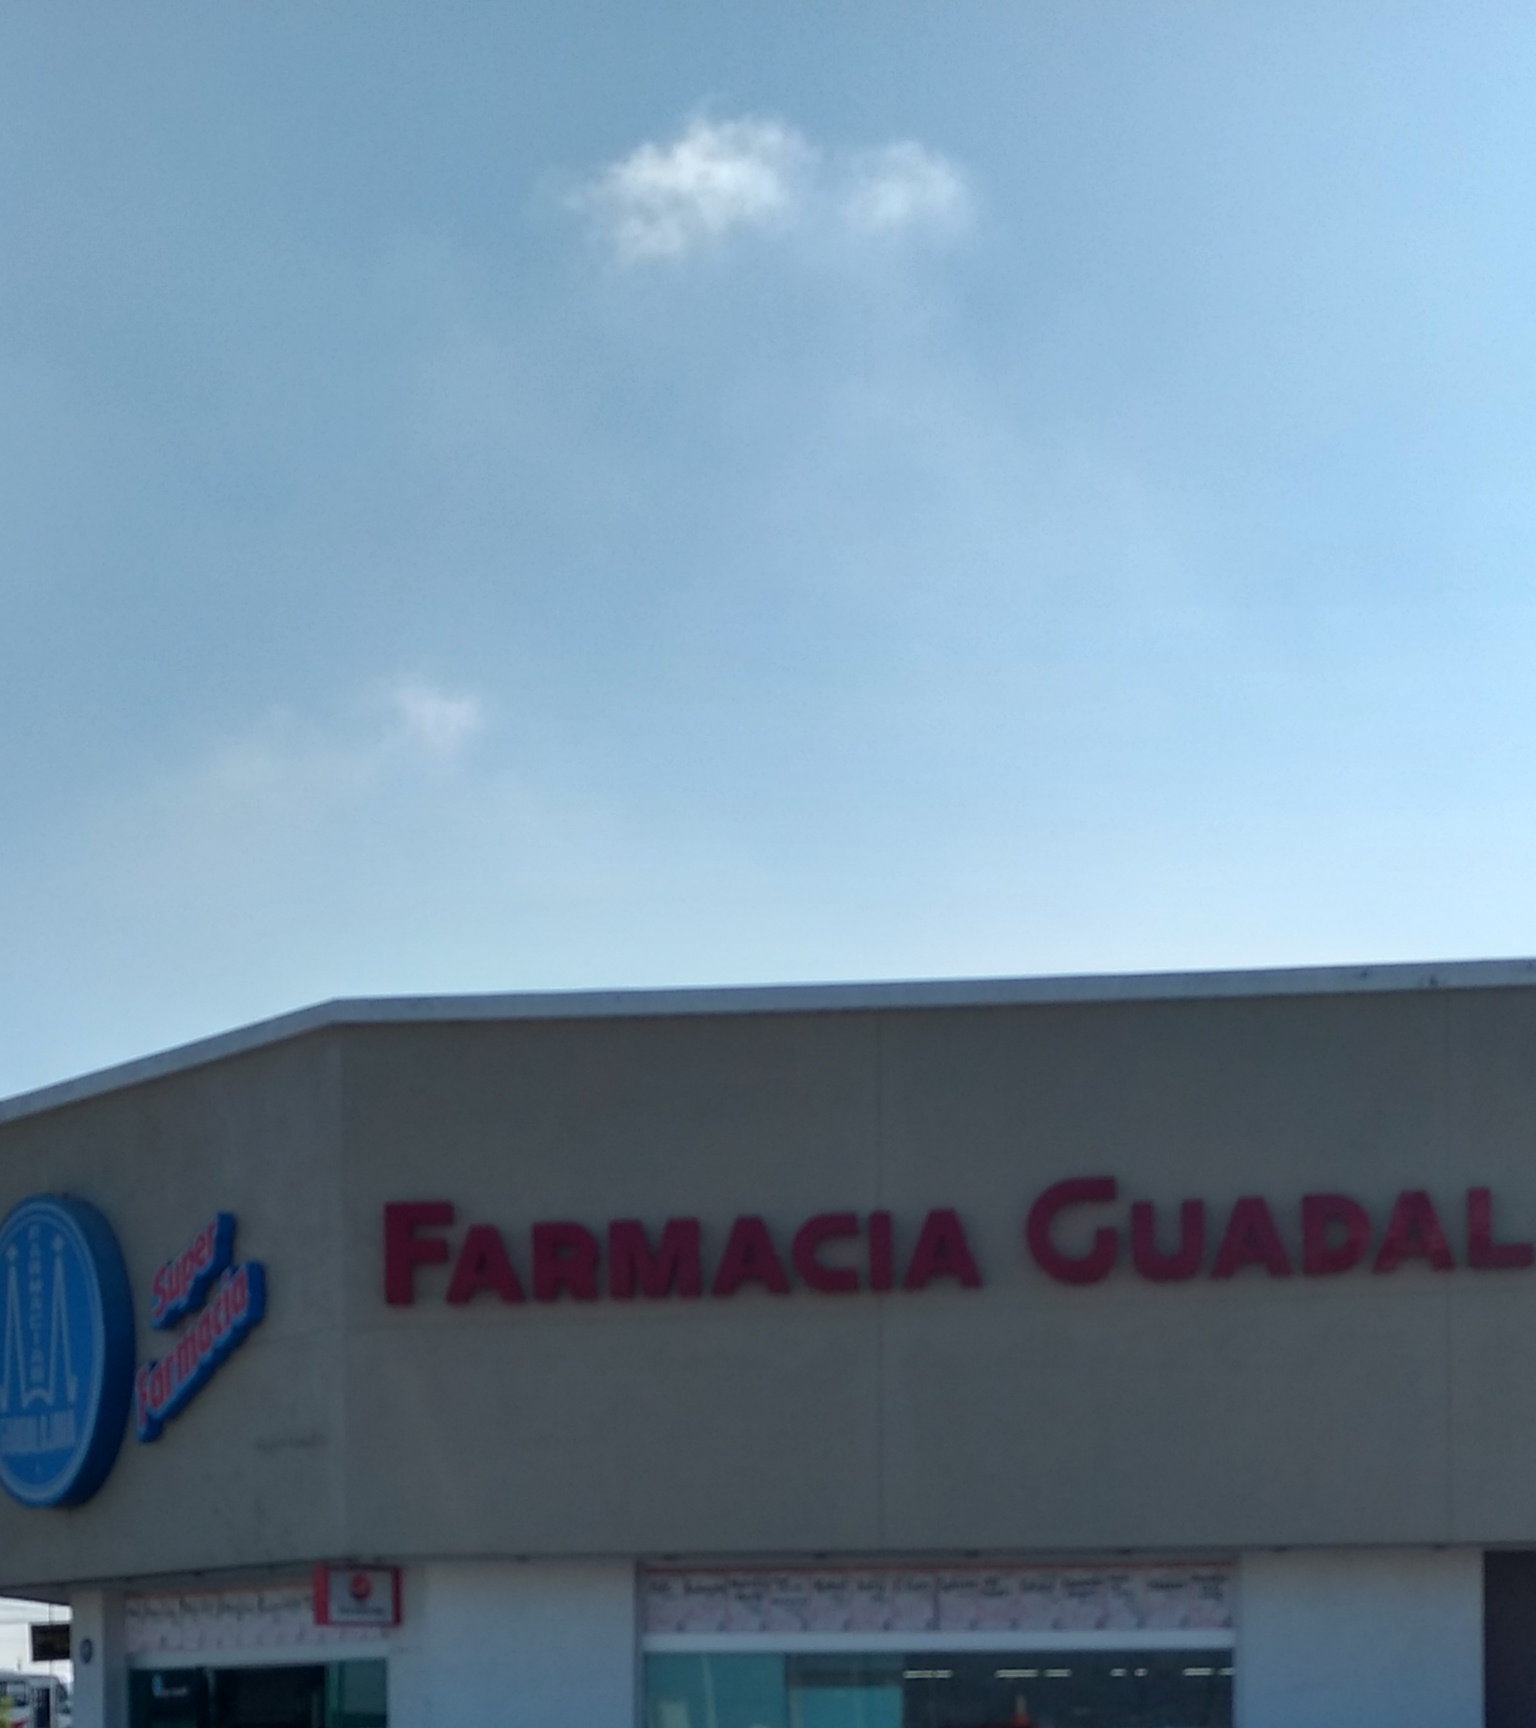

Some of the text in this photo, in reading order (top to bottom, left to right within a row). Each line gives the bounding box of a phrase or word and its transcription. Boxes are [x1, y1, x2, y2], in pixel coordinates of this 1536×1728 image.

[151, 1217, 219, 1321] Super
[383, 1200, 984, 1307] FARMACIA
[136, 1265, 249, 1430] Farmacia
